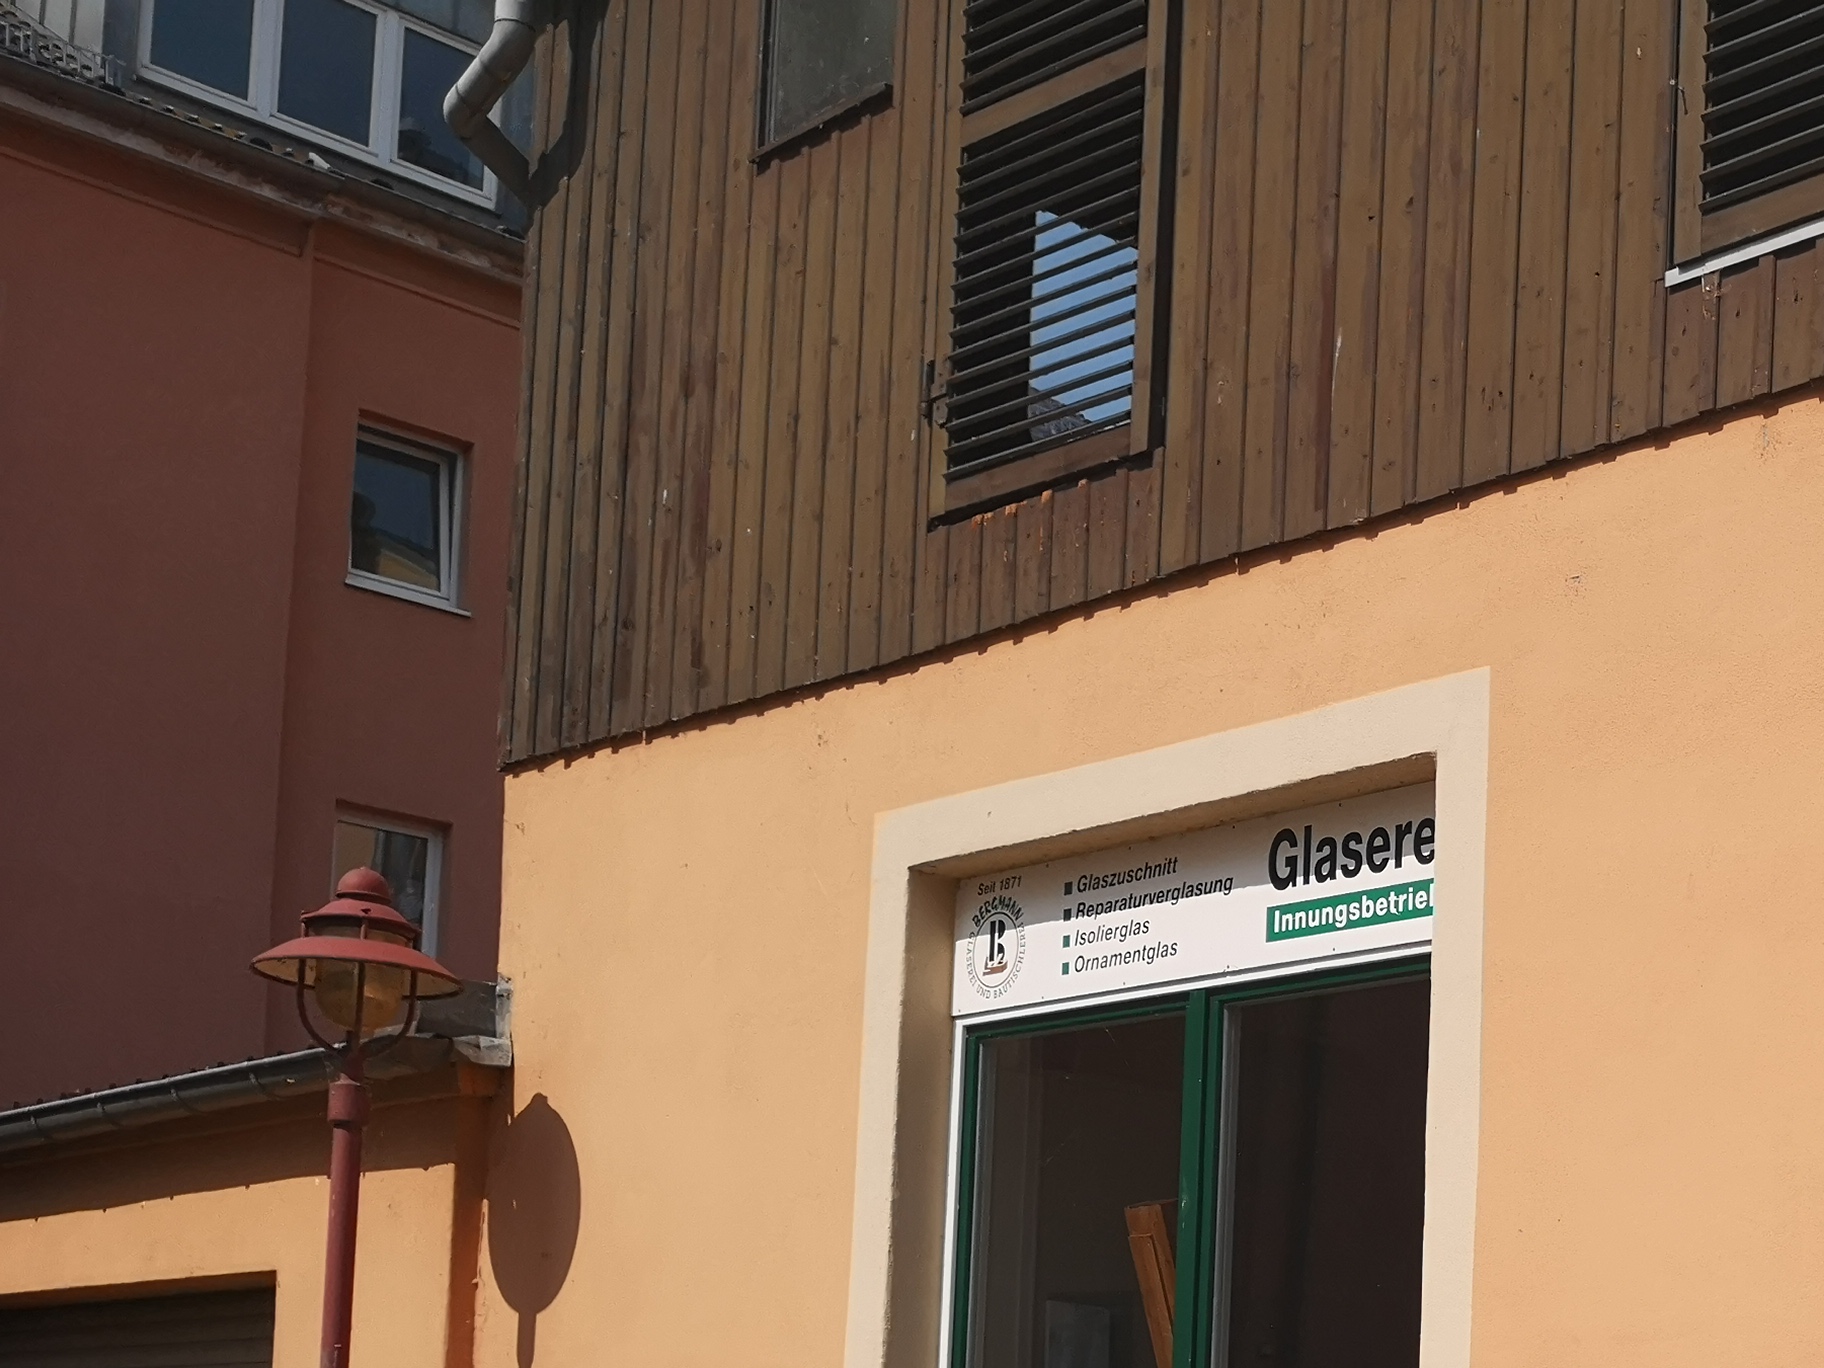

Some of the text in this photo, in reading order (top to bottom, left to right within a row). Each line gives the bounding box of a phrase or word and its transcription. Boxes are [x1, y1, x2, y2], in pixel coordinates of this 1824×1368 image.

[1268, 817, 1436, 891] Glasere
[977, 875, 1022, 896] Seit 1871
[1076, 856, 1179, 893] Glaszuschnitt
[972, 895, 1024, 928] BERGMANN
[1075, 877, 1234, 920] Reparaturverglasung
[1074, 919, 1151, 947] Isolierglas
[1074, 941, 1179, 973] Ornamentglas
[976, 985, 992, 1000] UND
